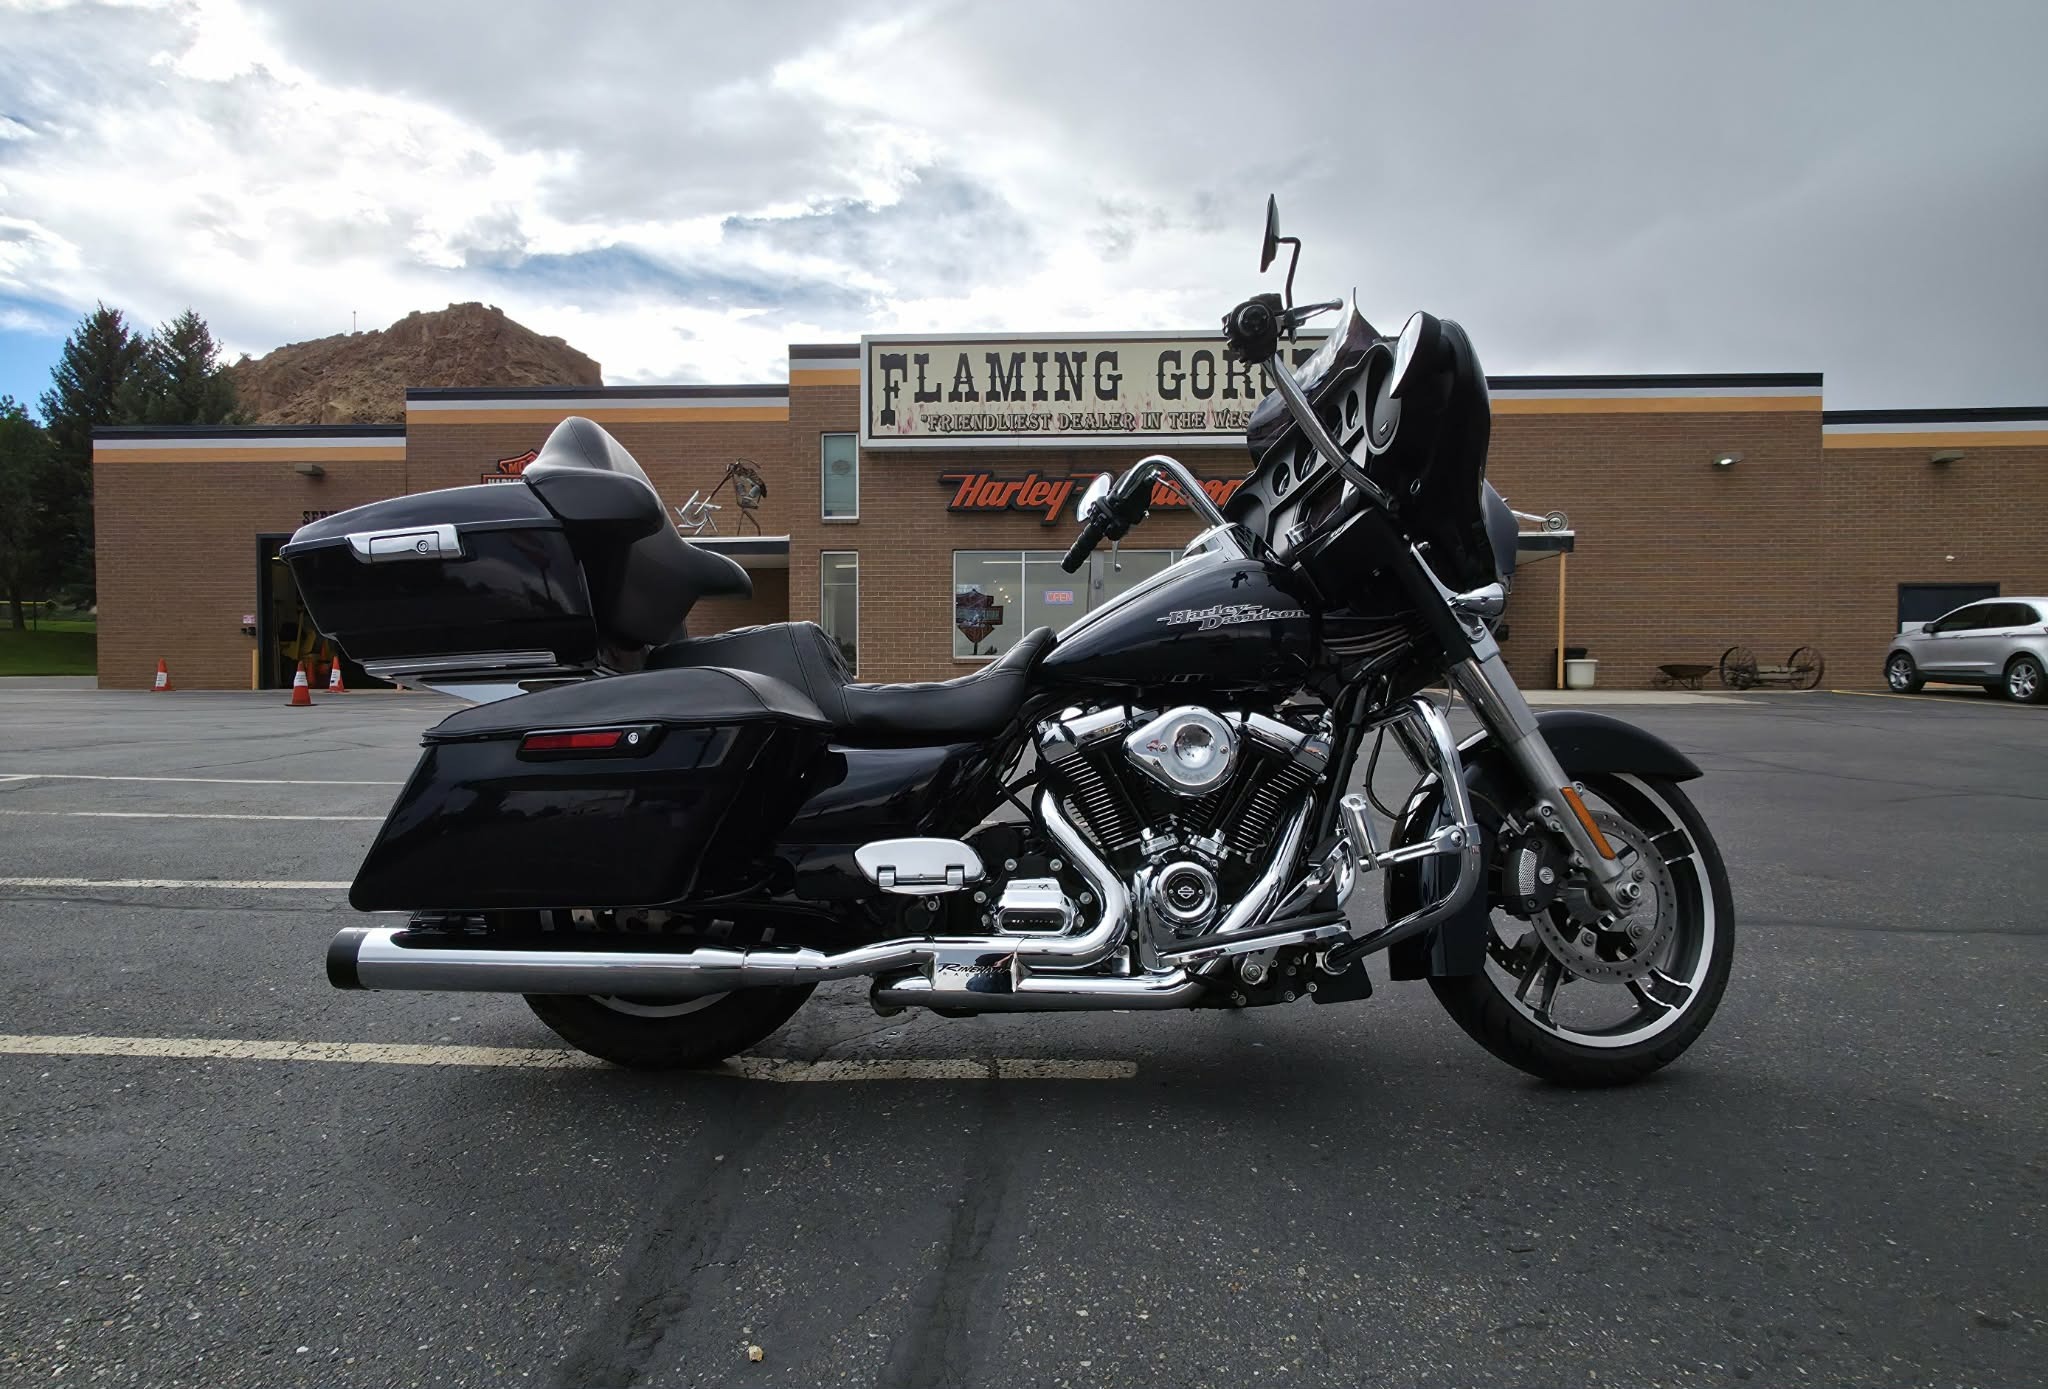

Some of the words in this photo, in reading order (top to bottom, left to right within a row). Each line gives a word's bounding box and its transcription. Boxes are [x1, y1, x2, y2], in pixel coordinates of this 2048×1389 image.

[880, 351, 1123, 427] FLAMING
[1156, 349, 1319, 401] GOR
[1058, 412, 1136, 431] DEALER
[1141, 411, 1162, 429] IN
[1168, 411, 1206, 429] THE
[1213, 408, 1252, 429] WES
